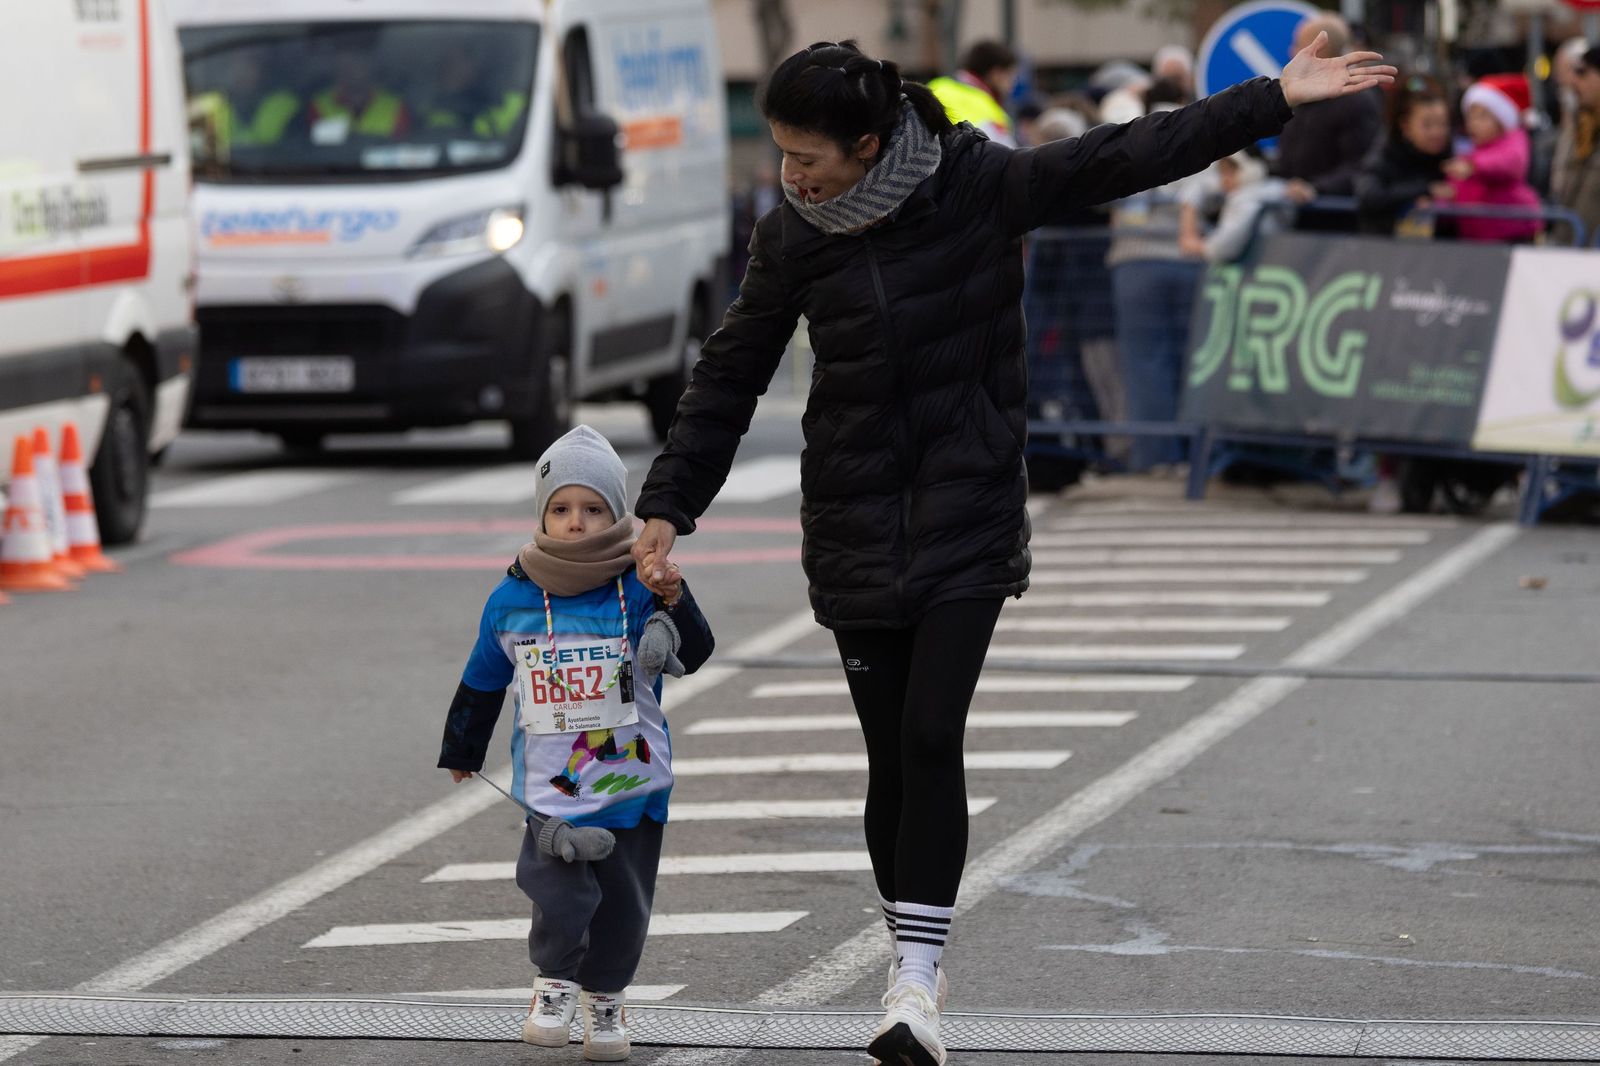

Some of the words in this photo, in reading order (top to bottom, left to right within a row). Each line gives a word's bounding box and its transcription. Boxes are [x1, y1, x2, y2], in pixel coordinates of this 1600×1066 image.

[1188, 264, 1383, 397] JRG
[542, 646, 619, 664] SETEL
[531, 666, 605, 704] 6852
[553, 702, 583, 711] CARLOS
